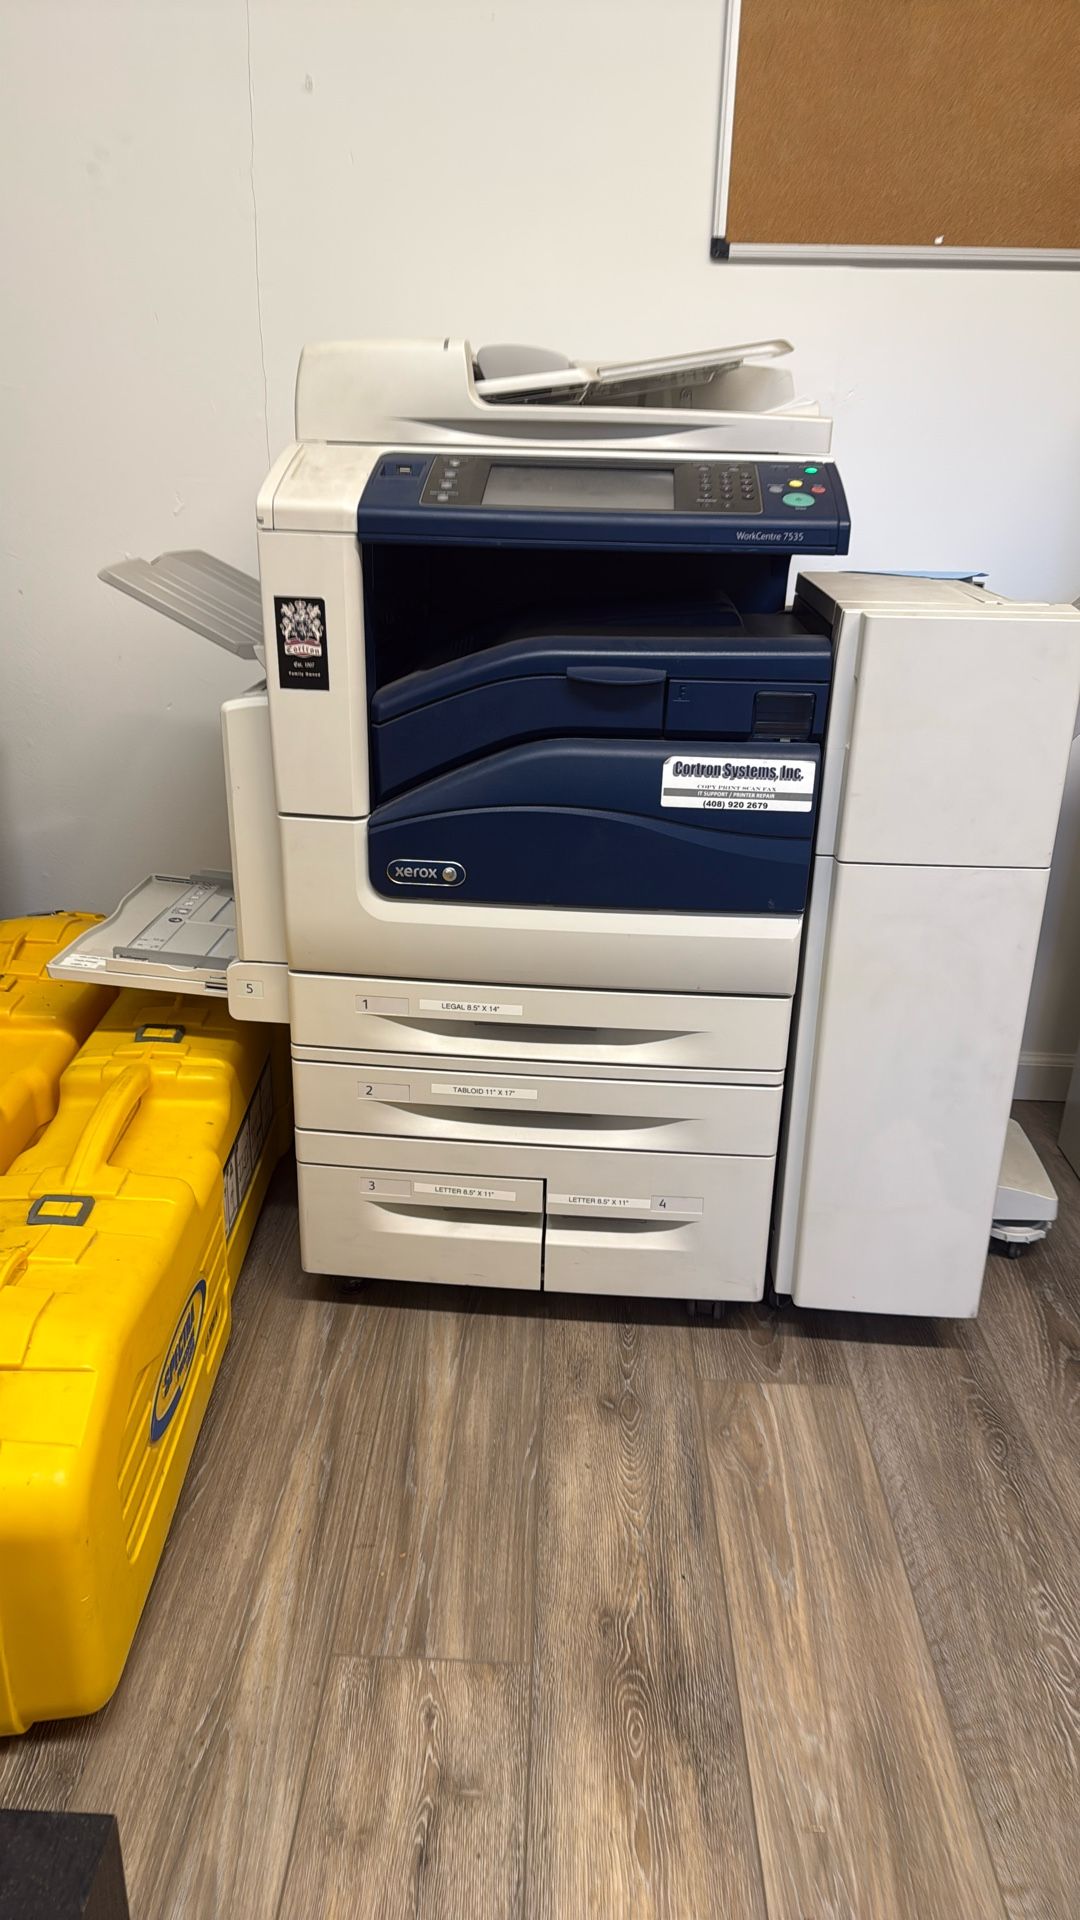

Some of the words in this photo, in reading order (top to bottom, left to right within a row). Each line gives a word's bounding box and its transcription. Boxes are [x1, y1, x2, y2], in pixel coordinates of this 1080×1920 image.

[736, 531, 782, 541] WorkCentre
[783, 532, 804, 541] 7535
[673, 761, 721, 778] Cortron
[722, 763, 779, 782] Systems,
[780, 765, 804, 782] Inc.
[703, 800, 725, 809] (408)
[395, 866, 437, 879] xerox
[246, 983, 254, 994] 5
[362, 999, 368, 1010] 1
[441, 1002, 465, 1011] LEGAL
[466, 1004, 481, 1012] 8.5"
[488, 1005, 500, 1013] 14"
[366, 1085, 373, 1096] 2
[453, 1086, 484, 1095] TABLOID
[504, 1089, 515, 1097] 17"
[368, 1181, 376, 1191] 3
[434, 1186, 462, 1195] LETTER
[463, 1188, 476, 1196] 8.5"
[484, 1190, 495, 1198] 11"
[568, 1196, 596, 1205] LETTER
[659, 1199, 666, 1209] 4
